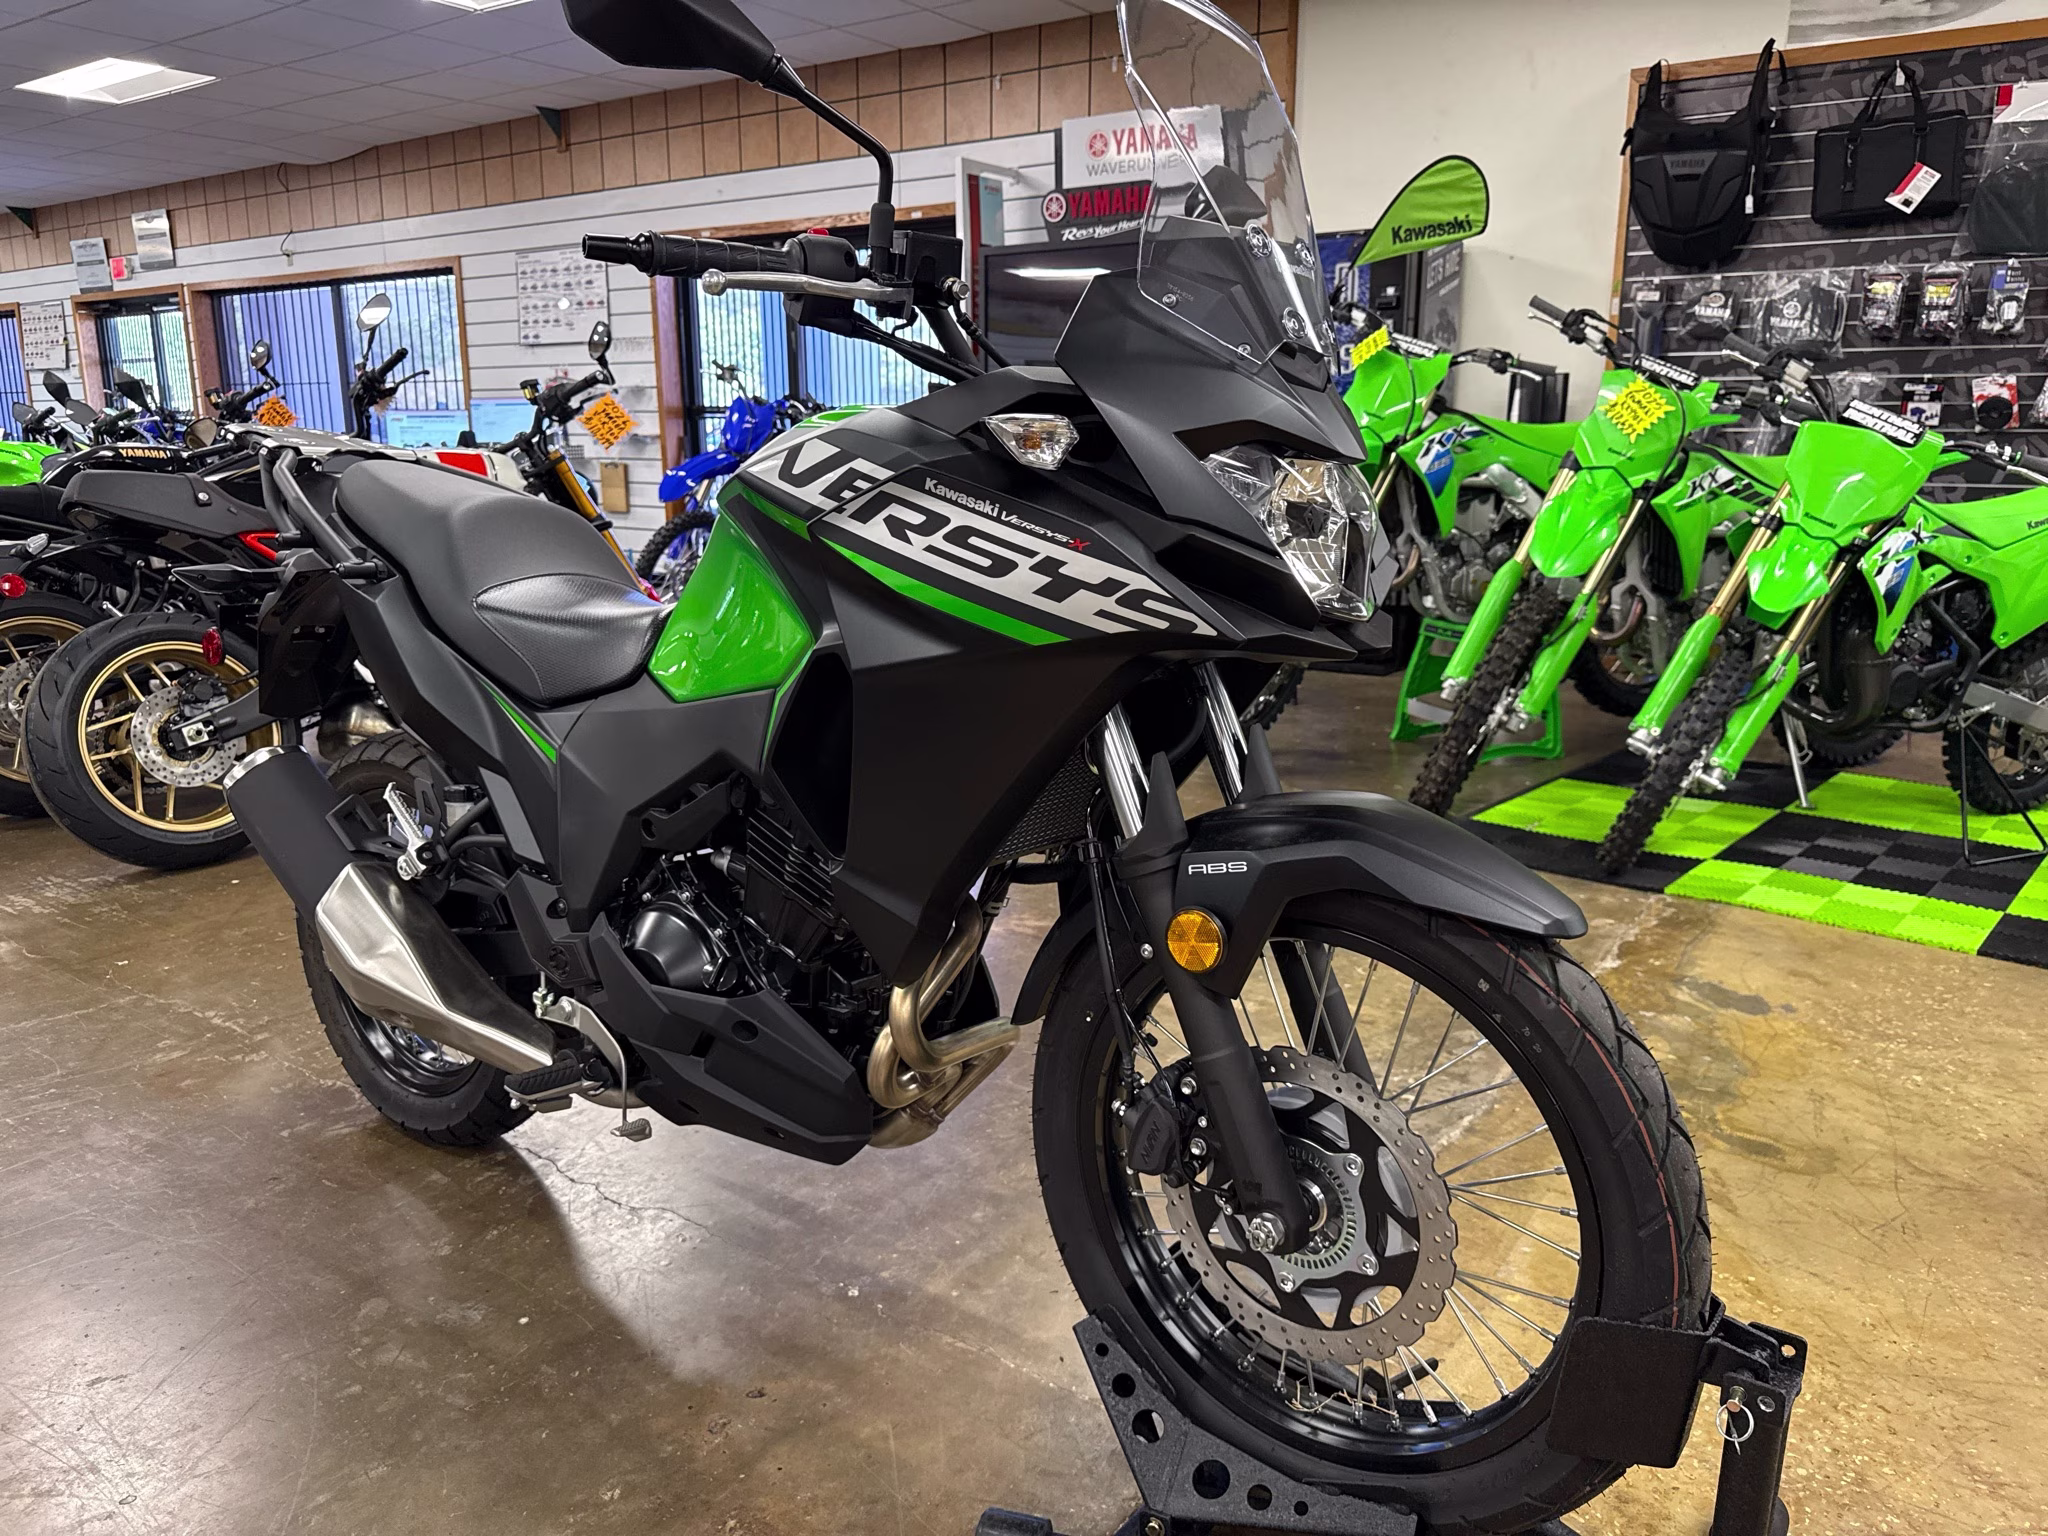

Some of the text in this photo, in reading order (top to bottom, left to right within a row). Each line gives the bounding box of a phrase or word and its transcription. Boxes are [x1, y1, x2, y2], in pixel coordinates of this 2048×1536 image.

[1112, 122, 1198, 156] YAMAA
[1391, 214, 1473, 245] Kawasaki
[119, 448, 168, 460] YAMAHA
[924, 476, 1000, 518] Kawasaki
[778, 441, 1202, 636] VERSYS
[1187, 861, 1248, 876] ABS
